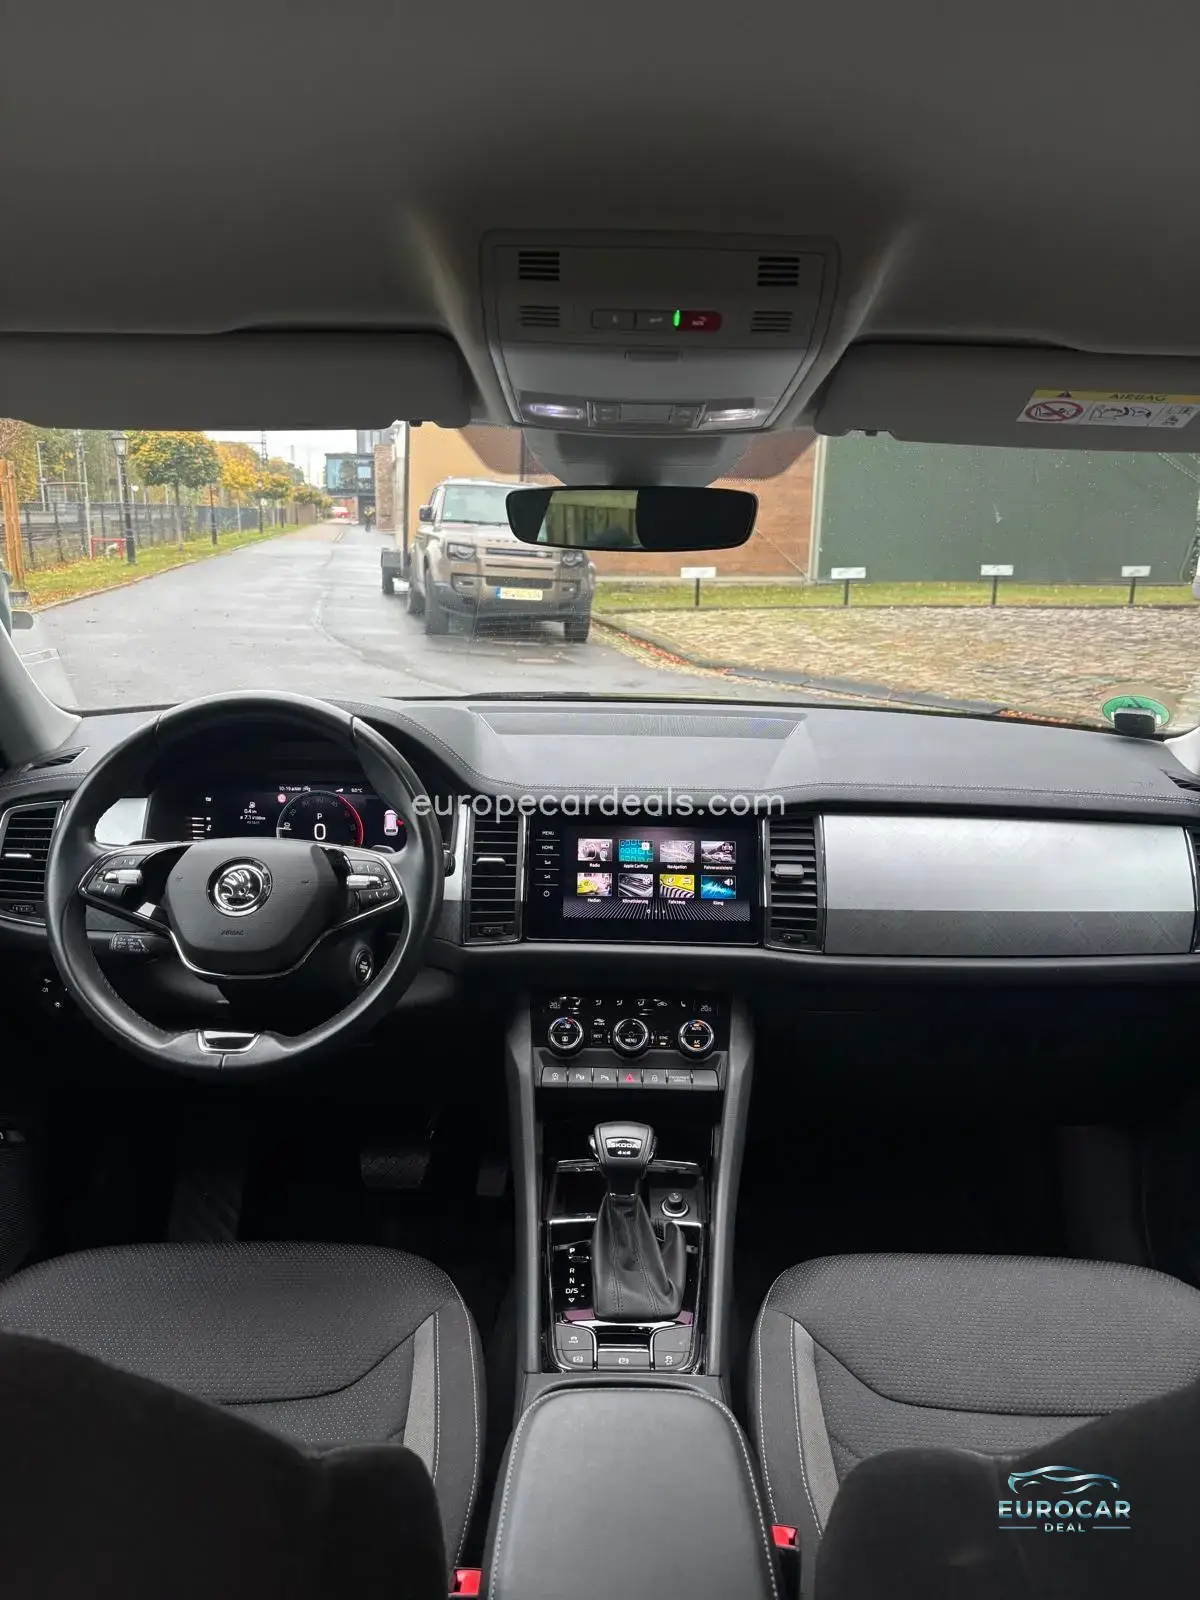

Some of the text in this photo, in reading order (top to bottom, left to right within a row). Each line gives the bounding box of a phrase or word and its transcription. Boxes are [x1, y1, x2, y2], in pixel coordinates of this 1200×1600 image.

[1108, 392, 1167, 402] AIRBAG
[316, 812, 323, 820] P
[313, 823, 326, 840] 0
